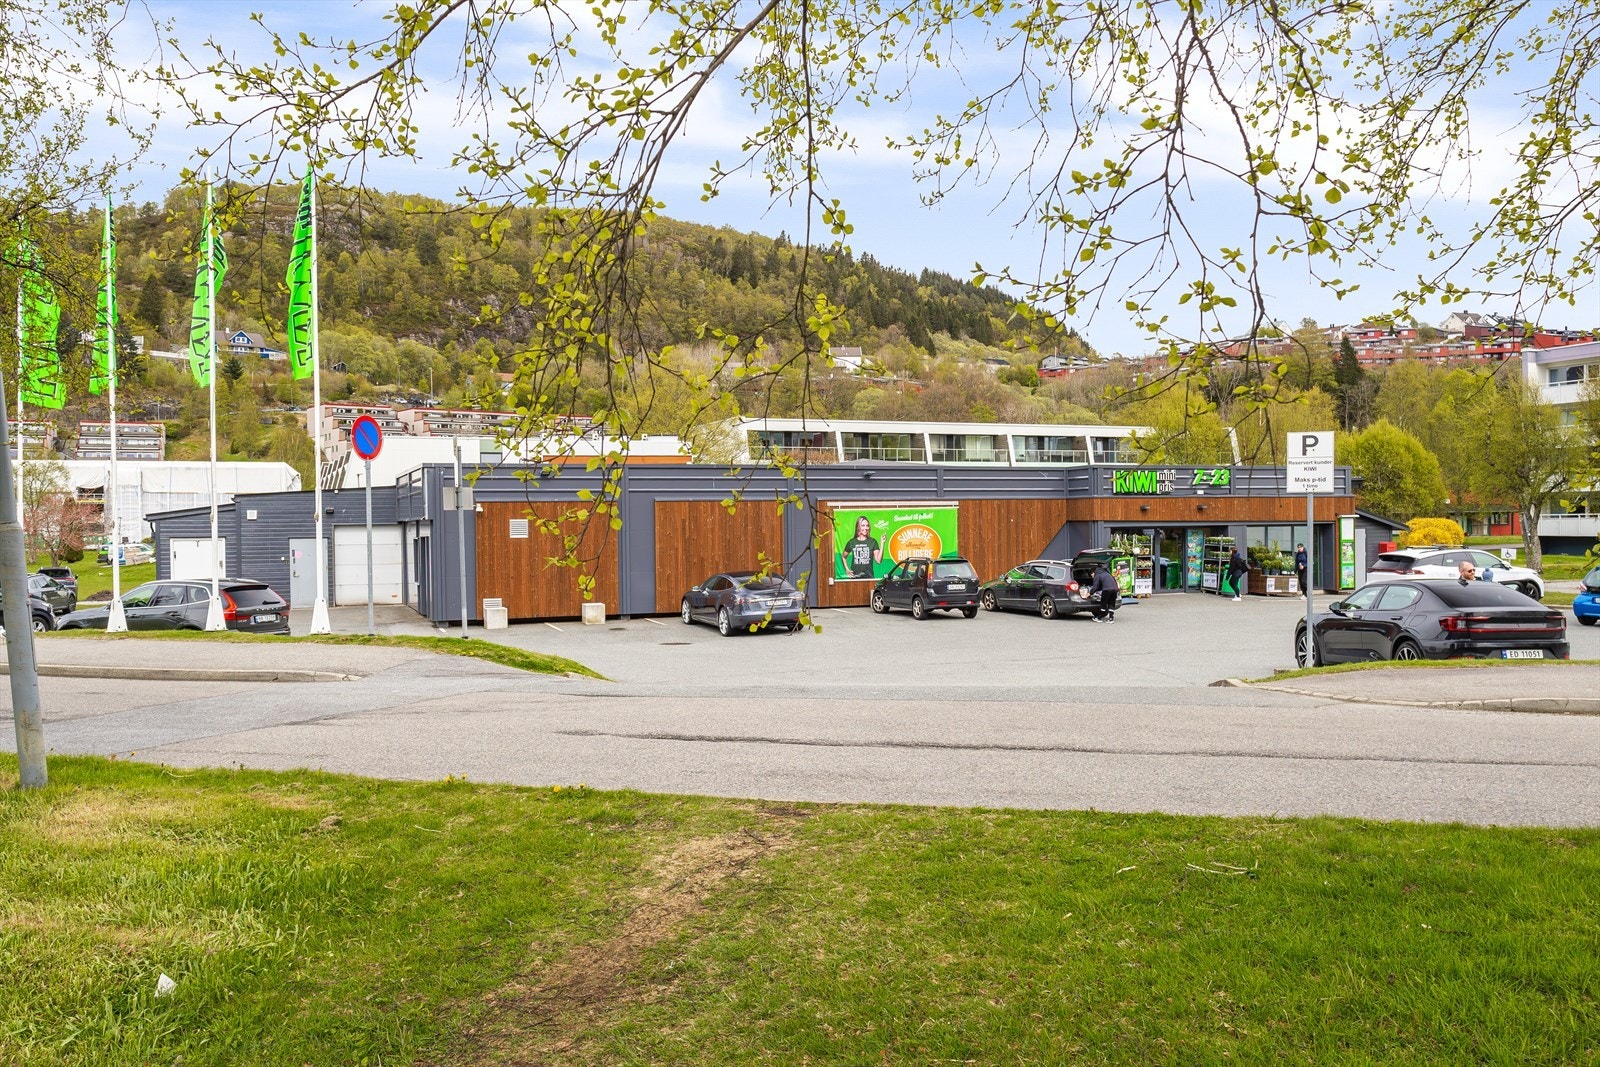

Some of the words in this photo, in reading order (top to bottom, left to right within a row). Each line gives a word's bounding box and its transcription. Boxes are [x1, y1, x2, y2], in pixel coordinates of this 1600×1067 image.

[1302, 435, 1319, 456] P
[1113, 470, 1157, 494] KIWI
[1157, 469, 1176, 480] mini
[1157, 481, 1175, 494] pris
[898, 528, 933, 544] SUNNERE
